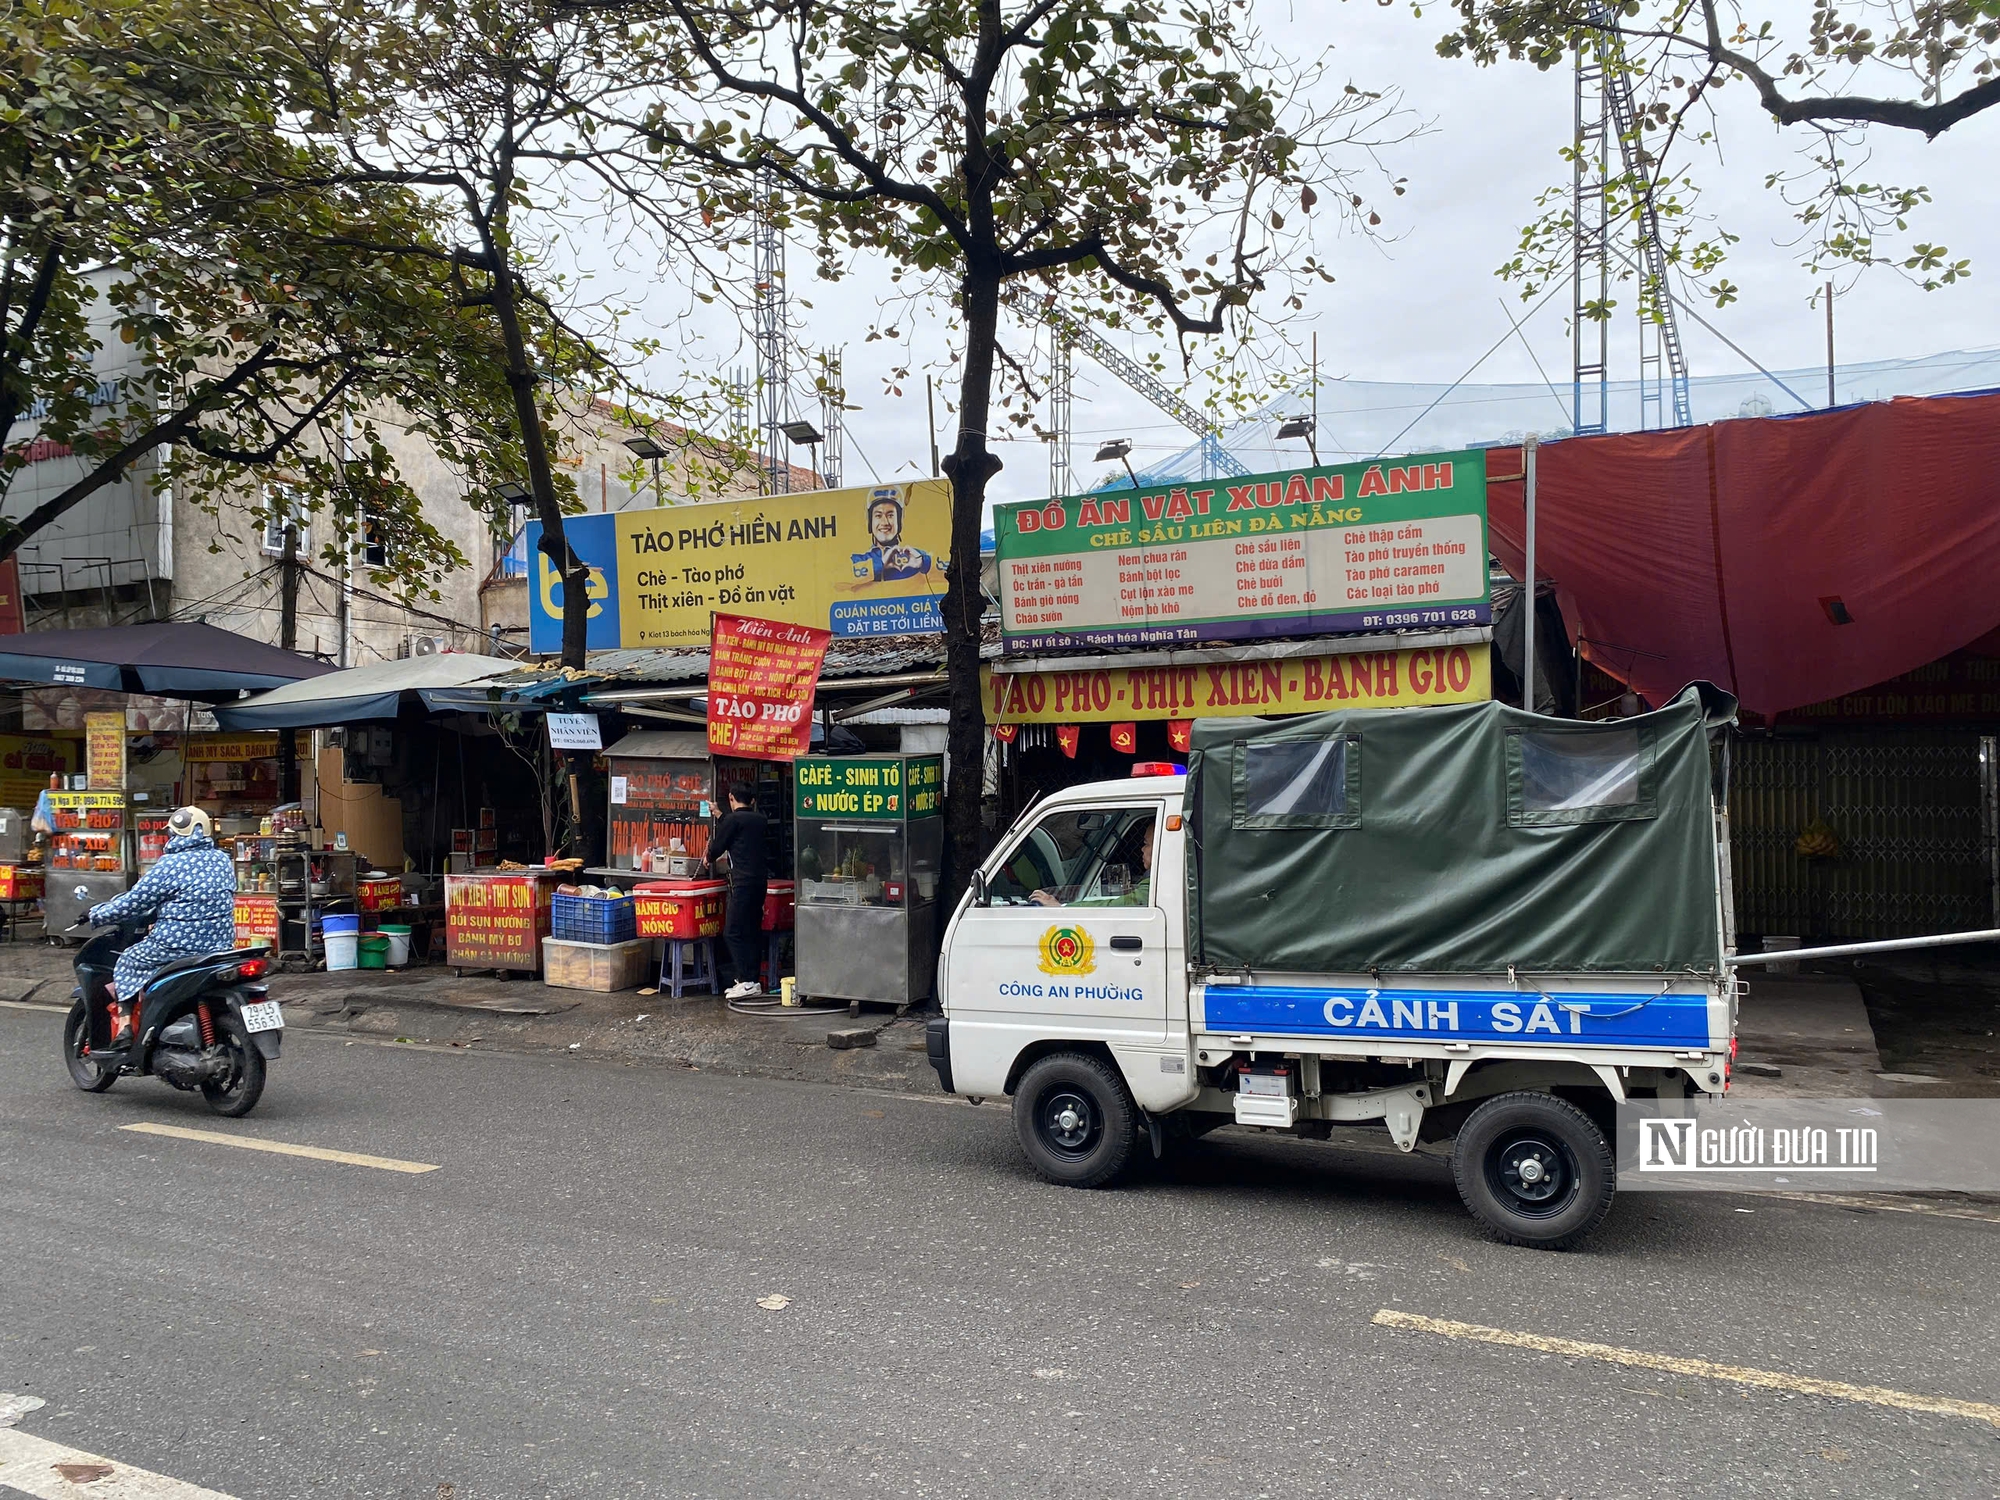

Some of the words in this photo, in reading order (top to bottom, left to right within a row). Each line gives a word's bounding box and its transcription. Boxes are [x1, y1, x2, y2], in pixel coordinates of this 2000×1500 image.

[1016, 499, 1067, 534] ĐỒ
[1076, 498, 1132, 528] ĂN
[1141, 487, 1216, 523] VẶT
[1225, 473, 1345, 513] XUÂN
[1356, 461, 1454, 499] ÁNH
[631, 527, 673, 553] TÀO
[679, 521, 725, 550] PHỚ
[731, 513, 781, 545] HIỀN
[787, 516, 836, 541] ANH
[1090, 528, 1133, 548] CHÈ
[1138, 521, 1184, 542] SẦU
[1190, 518, 1242, 538] LIÊN
[1249, 513, 1284, 533] ĐÀ
[1291, 504, 1363, 529] NẴNG
[1344, 530, 1365, 545] Chè
[1369, 528, 1394, 545] thập
[1397, 524, 1423, 541] cẩm
[1235, 542, 1255, 555] Chè
[1258, 539, 1277, 553] sầu
[1280, 538, 1301, 551] liên
[1345, 549, 1365, 564] Tào
[1368, 547, 1390, 563] phớ
[1393, 543, 1429, 559] truyền
[1432, 540, 1466, 556] thống
[1118, 555, 1140, 566] Nem
[1144, 552, 1167, 564] chua
[1170, 550, 1187, 561] rán
[1236, 560, 1256, 573] Chè
[638, 568, 666, 586] Chè
[682, 567, 711, 583] Tào
[715, 564, 744, 584] phớ
[1012, 564, 1028, 577] Thịt
[1031, 562, 1051, 574] xiên
[1054, 559, 1082, 571] nướng
[1119, 571, 1144, 583] Bánh
[1147, 569, 1162, 583] bột
[1165, 568, 1180, 581] lọc
[1345, 568, 1366, 582] Tào
[1368, 565, 1390, 580] phớ
[1393, 563, 1445, 578] caramen
[1139, 587, 1154, 601] lộn
[1157, 585, 1175, 597] xào
[1179, 585, 1194, 595] me
[1237, 577, 1257, 590] Chè
[1347, 585, 1368, 600] Các
[1371, 583, 1393, 600] loại
[1396, 581, 1415, 596] tào
[1418, 580, 1440, 595] phớ
[638, 593, 668, 613] Thịt
[672, 592, 703, 608] xiên
[719, 585, 741, 604] Đồ
[746, 588, 764, 603] ăn
[768, 584, 795, 605] vặt
[1014, 597, 1037, 607] Bánh
[1040, 594, 1054, 607] giò
[1056, 593, 1079, 605] nóng
[1238, 595, 1258, 608] Chè
[835, 603, 867, 619] QUÁN
[871, 603, 908, 617] NGON,
[911, 599, 932, 613] GIÁ
[1015, 612, 1039, 624] Cháo
[1121, 605, 1144, 619] Nộm
[1147, 603, 1159, 615] bò
[1162, 601, 1180, 614] khô
[1363, 615, 1383, 626] ĐT:
[1386, 613, 1419, 625] 0396
[1422, 611, 1446, 623] 701
[1451, 609, 1476, 621] 628
[736, 619, 772, 638] Hiền
[777, 628, 811, 644] Anh
[847, 619, 869, 635] ĐẶT
[873, 620, 888, 631] BE
[890, 616, 910, 630] TỚI
[913, 612, 943, 627] LIỀN!
[1012, 639, 1029, 649] ĐC:
[1032, 638, 1042, 648] Ki
[1117, 632, 1138, 643] hóa
[1141, 630, 1173, 642] Nghĩa
[1176, 629, 1198, 640] Tân
[1127, 667, 1198, 716] THỊT
[716, 695, 756, 719] TÀO
[761, 701, 802, 722] PHỚ
[710, 719, 733, 746] CHÈ
[800, 764, 832, 785] CÀFÊ
[846, 768, 878, 786] SINH
[882, 762, 900, 786] TỐ
[817, 789, 858, 811] NƯỚC
[863, 790, 883, 812] ÉP
[492, 884, 510, 913] THỊT
[512, 884, 530, 913] SỤN
[635, 899, 660, 915] BÁNH
[234, 905, 250, 924] HÈ
[470, 916, 491, 929] SỤN
[494, 914, 530, 929] NƯỚNG
[641, 917, 674, 934] NÓNG
[458, 931, 486, 944] BÁNH
[999, 981, 1042, 997] CÔNG
[1048, 986, 1069, 998] AN
[1075, 982, 1143, 1000] PHƯỜNG
[1323, 990, 1459, 1031] CẢNH
[1491, 996, 1590, 1035] SÁT
